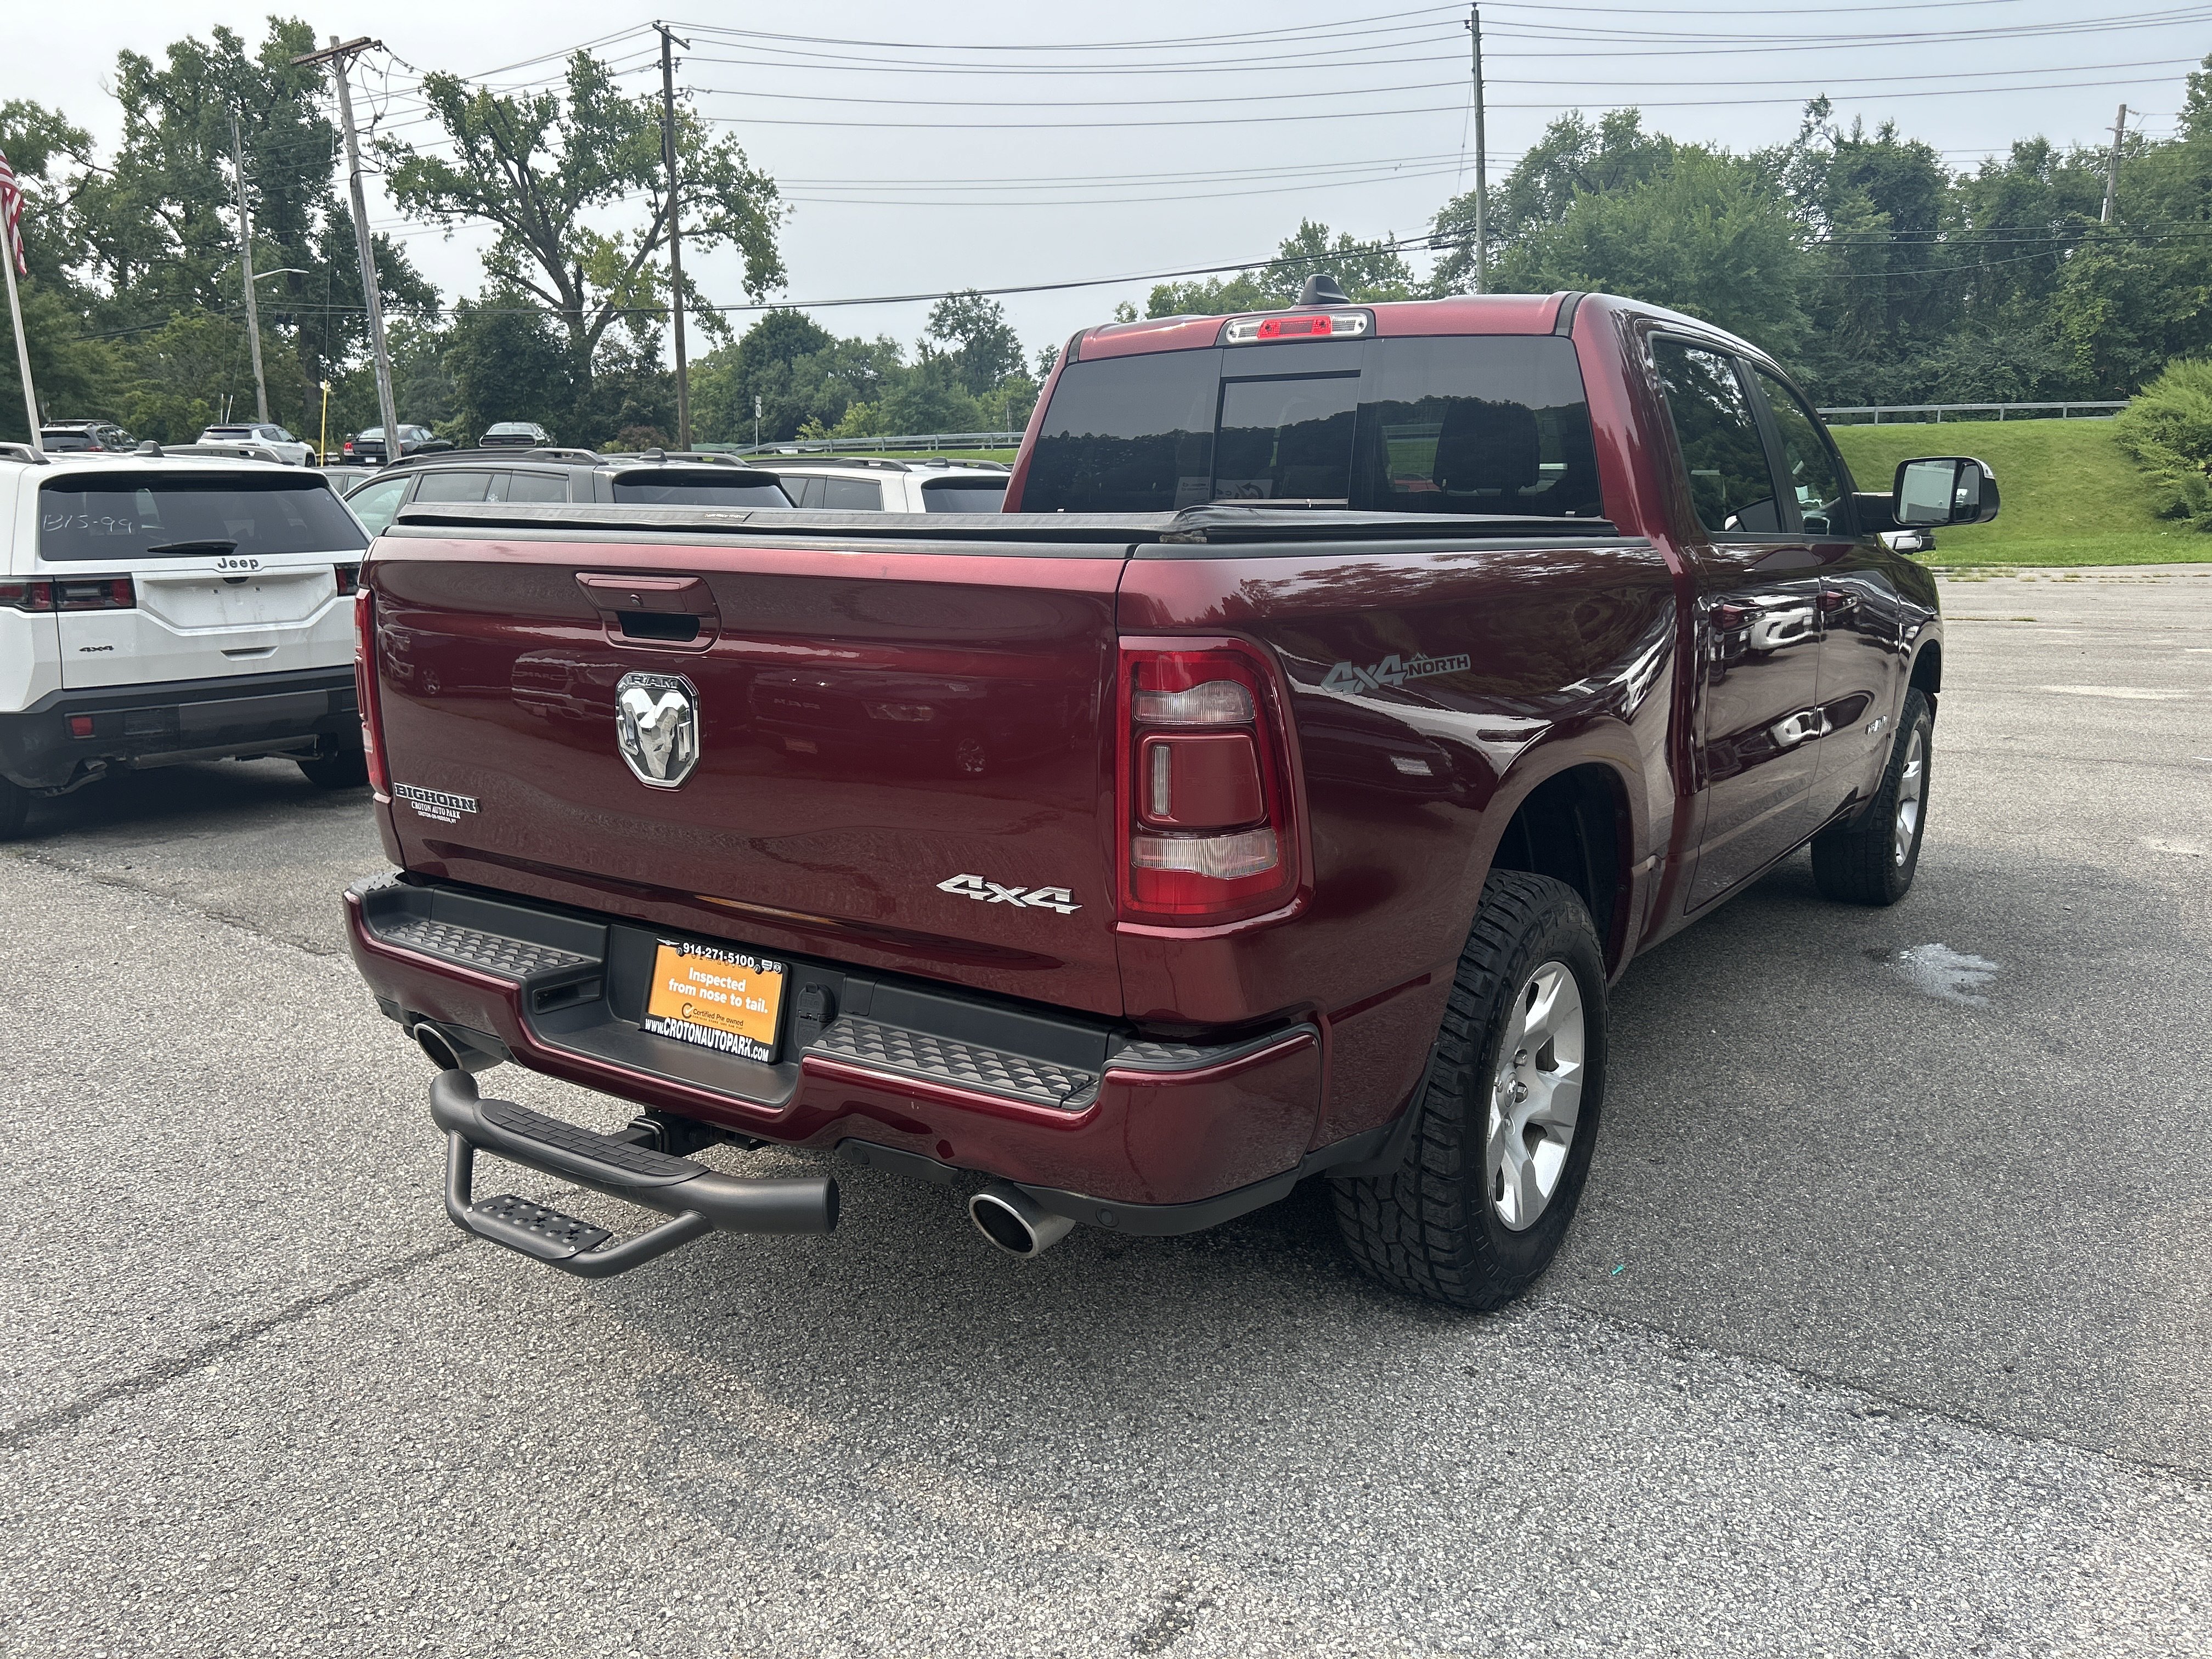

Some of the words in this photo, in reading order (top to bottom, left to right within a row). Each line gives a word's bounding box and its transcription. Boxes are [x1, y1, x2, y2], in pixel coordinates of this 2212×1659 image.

[218, 557, 259, 569] Jeep
[1408, 656, 1468, 676] NORTH
[630, 675, 678, 689] RAM
[394, 783, 477, 812] BIGHORN
[411, 801, 431, 812] CROTON
[432, 806, 446, 816] AUTO
[446, 809, 461, 819] PARK
[682, 943, 755, 967] 914-271-5100
[689, 967, 747, 992] Inspected
[668, 978, 696, 996] from
[699, 988, 727, 1004] nose
[730, 992, 742, 1007] to
[745, 996, 769, 1014] tail.
[693, 1008, 715, 1019] Certified
[716, 1013, 725, 1022] Pre
[726, 1018, 744, 1026] owned
